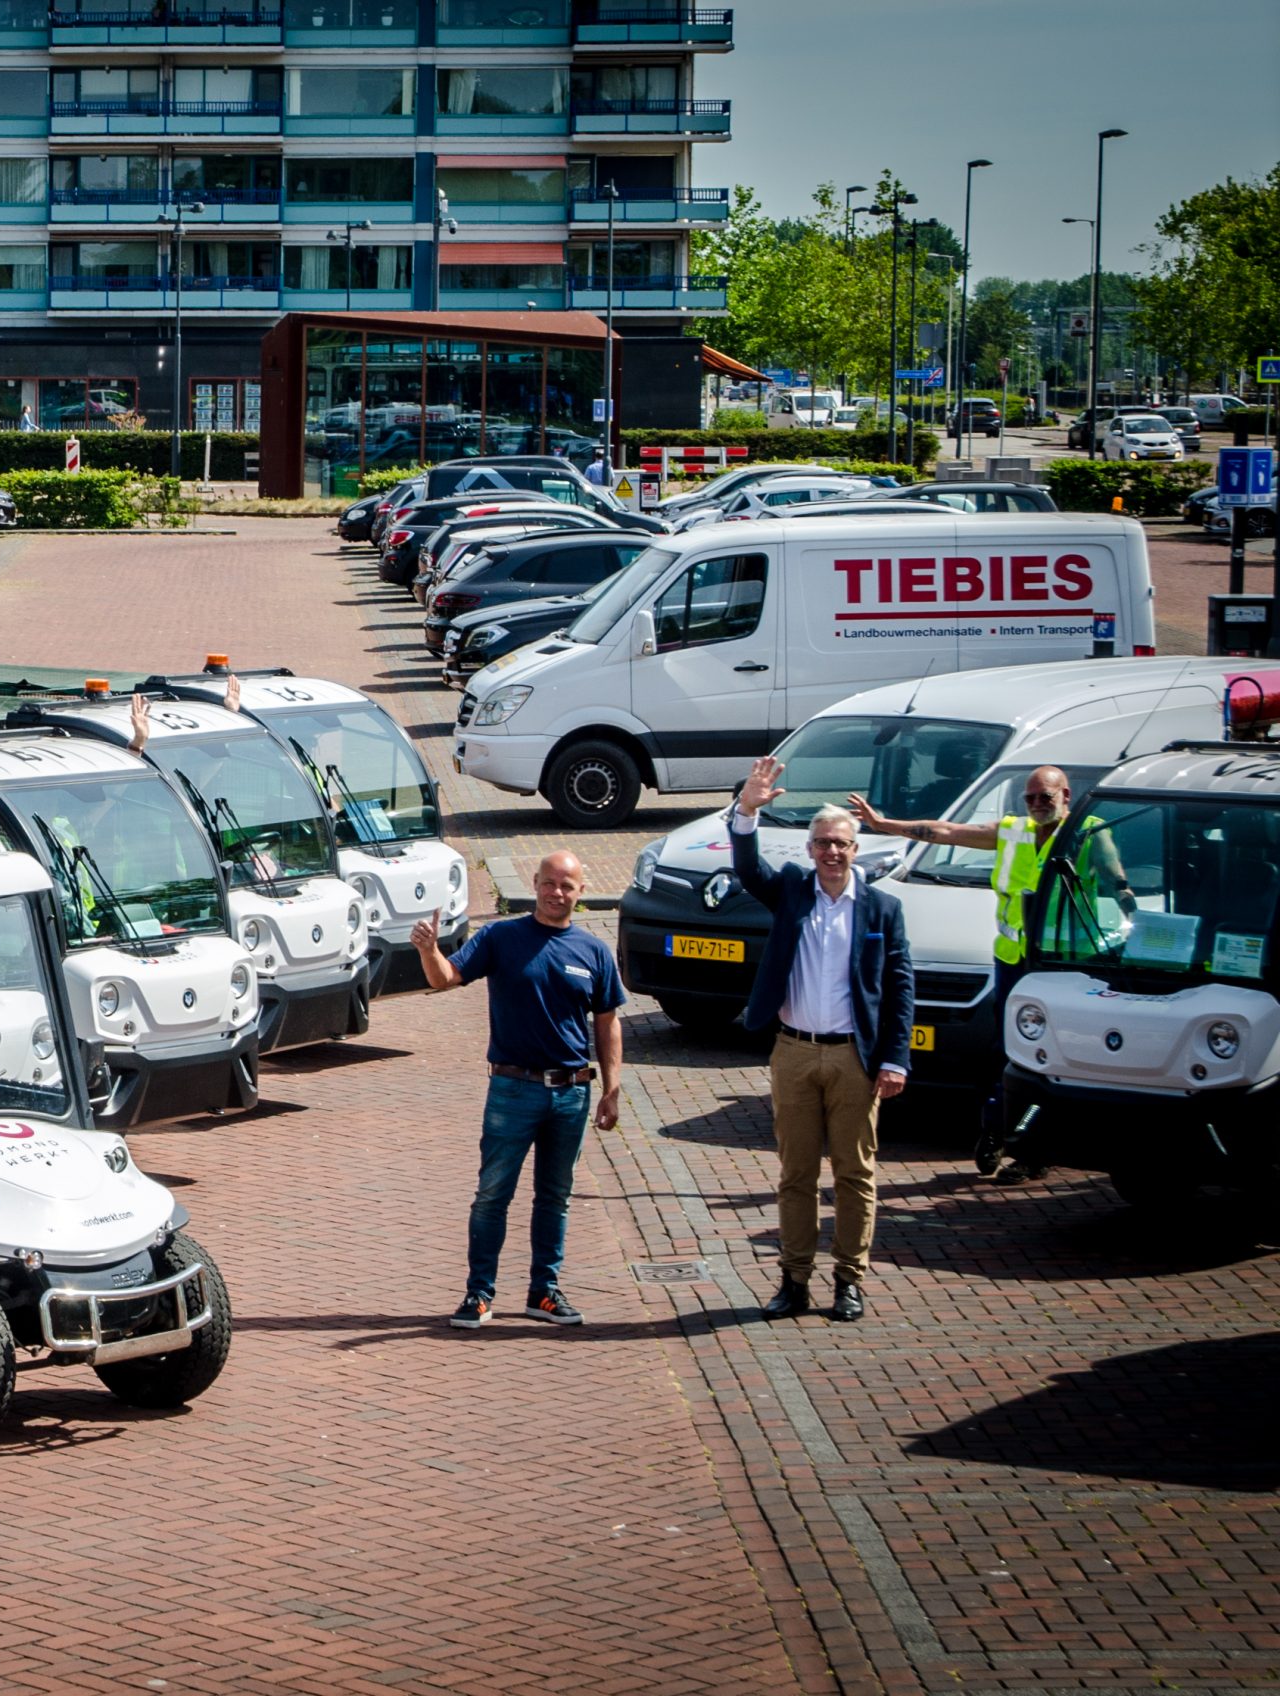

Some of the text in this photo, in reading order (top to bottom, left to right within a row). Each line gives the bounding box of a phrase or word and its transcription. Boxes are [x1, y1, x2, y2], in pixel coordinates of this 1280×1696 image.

[834, 554, 1093, 603] TIEBIES
[843, 624, 1094, 639] Landbouwmechanisatie Intern Transport
[680, 938, 736, 958] VFV-71-F
[5, 1149, 69, 1167] WERKT
